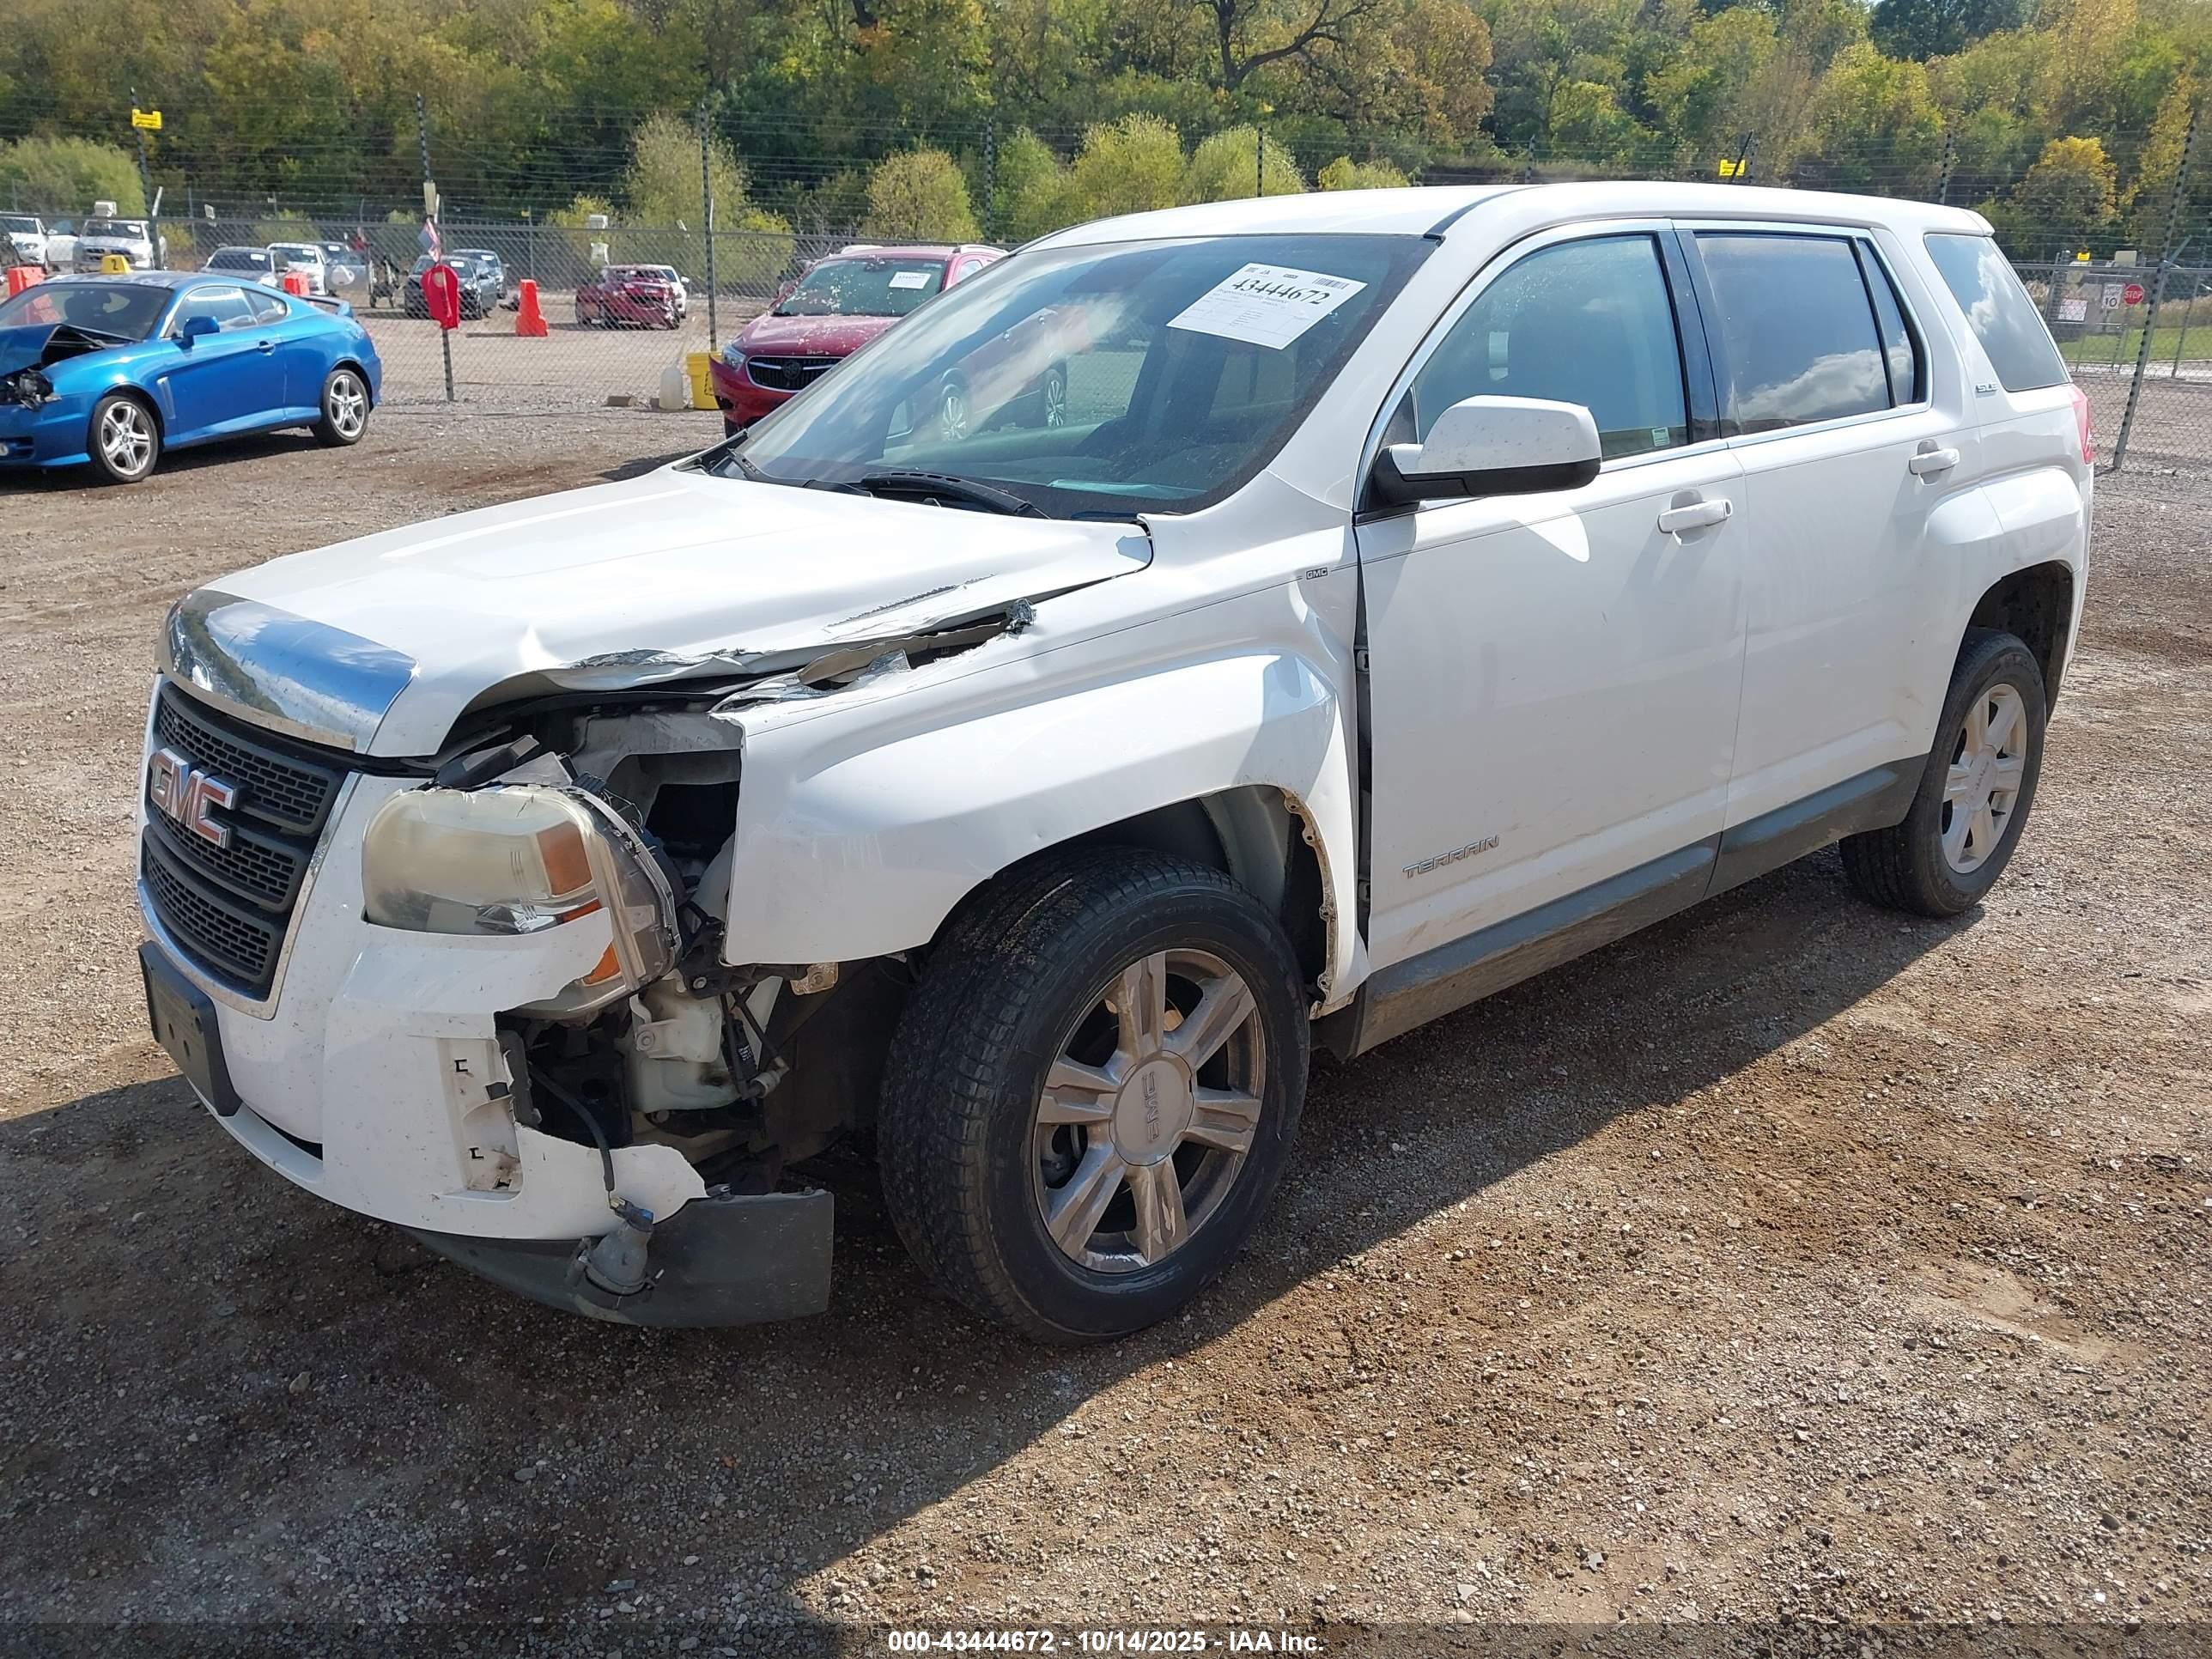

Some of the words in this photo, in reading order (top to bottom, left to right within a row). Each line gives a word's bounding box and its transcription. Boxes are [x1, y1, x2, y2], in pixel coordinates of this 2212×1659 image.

[111, 258, 119, 270] 2
[1231, 277, 1330, 305] 43444672
[2124, 290, 2144, 299] STOP
[2105, 297, 2118, 307] 10
[1306, 568, 1328, 579] GMC
[149, 747, 237, 849] GMC
[1401, 834, 1500, 879] TERRAIN
[1141, 1071, 1161, 1142] GMC
